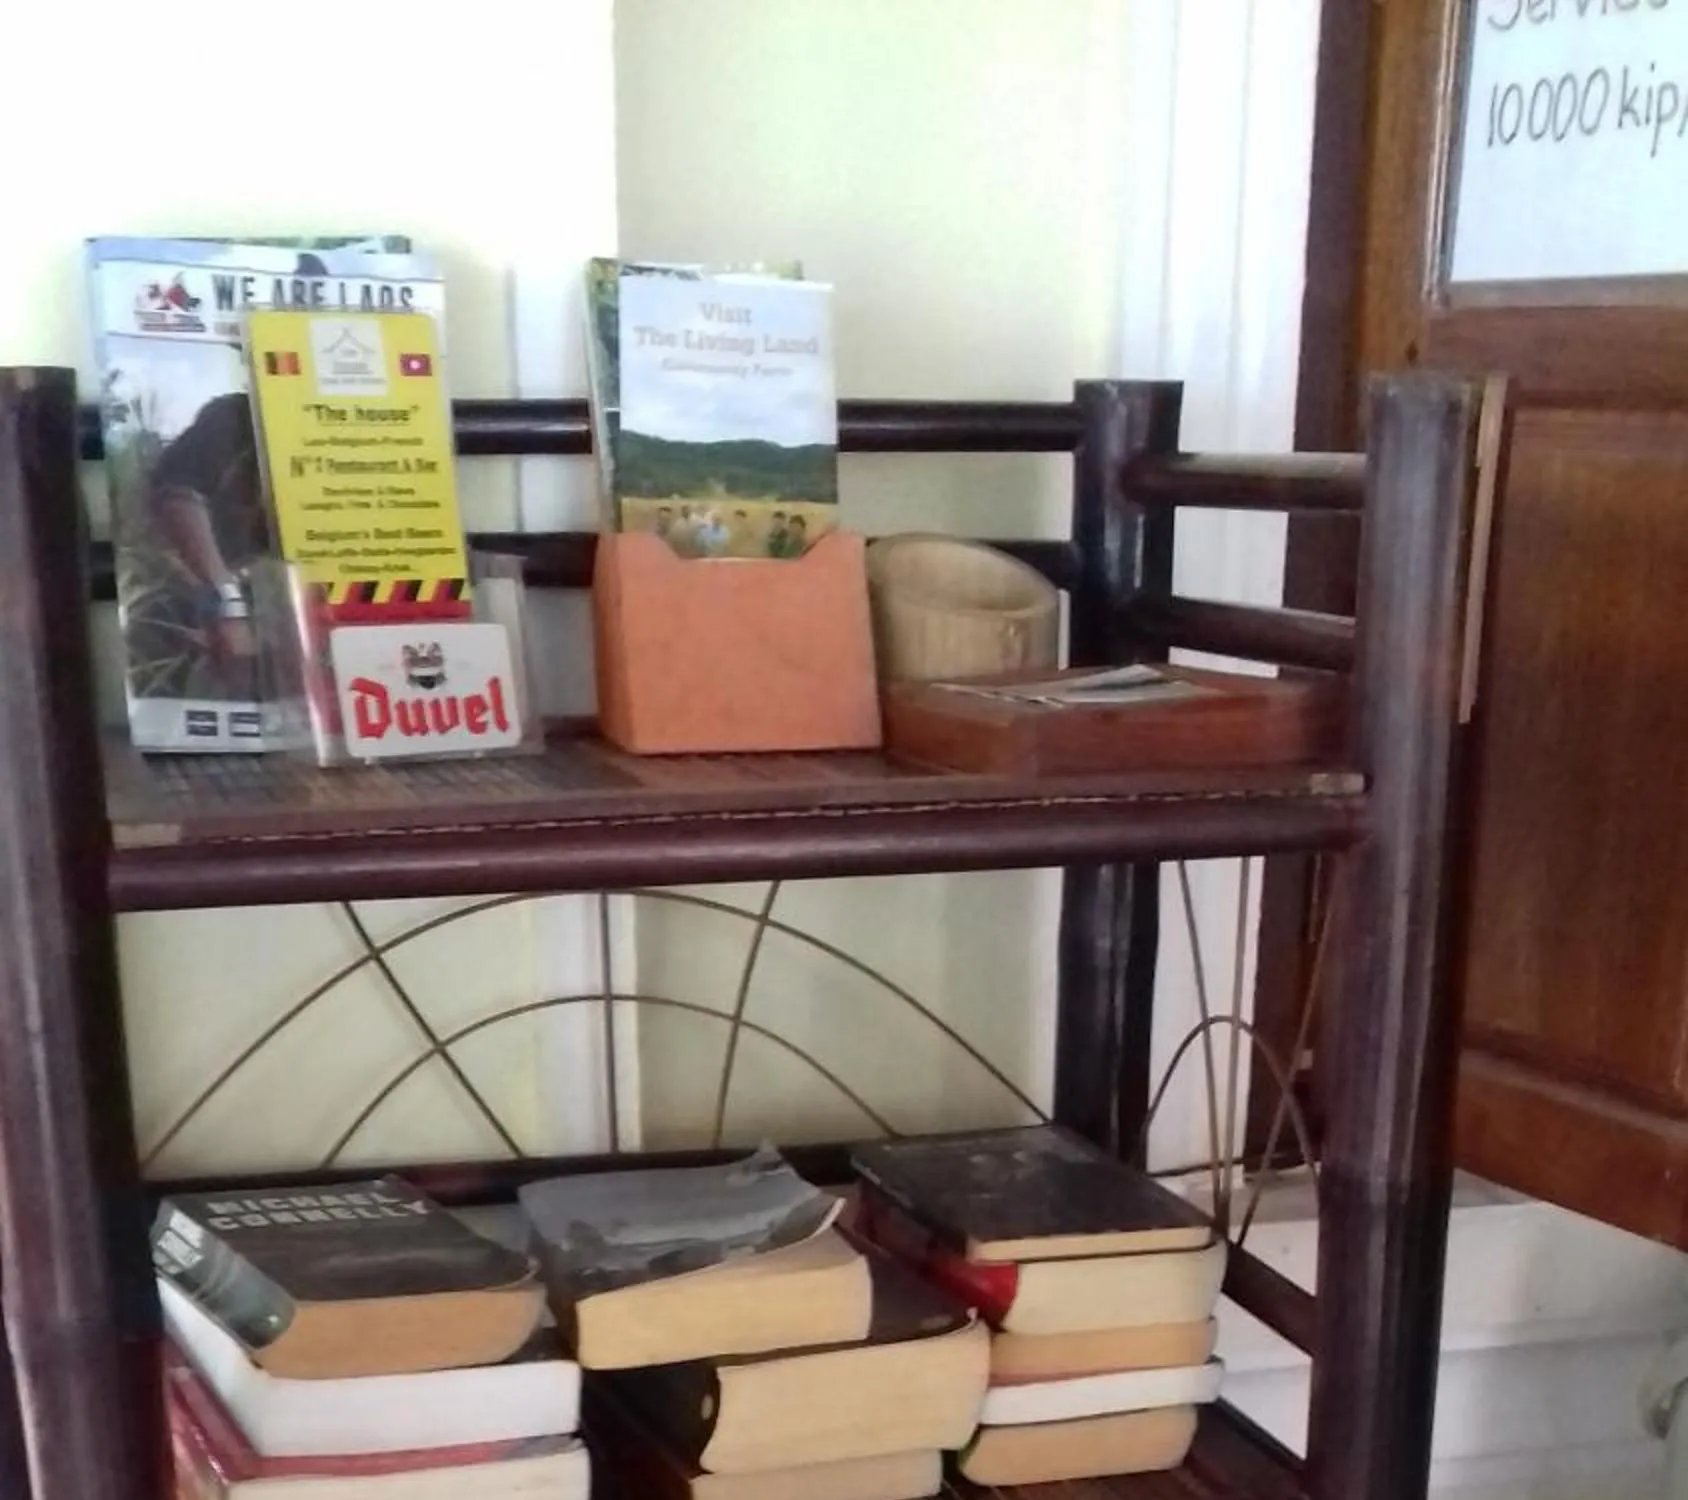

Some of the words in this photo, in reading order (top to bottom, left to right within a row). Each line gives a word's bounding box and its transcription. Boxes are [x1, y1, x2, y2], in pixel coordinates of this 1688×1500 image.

[211, 273, 256, 312] WE
[271, 277, 324, 312] ARE
[700, 302, 752, 325] Visit
[632, 325, 678, 348] The
[683, 328, 755, 357] Living
[763, 333, 820, 354] Land
[349, 675, 511, 740] Duvel
[206, 1192, 400, 1214] MICHAEL
[207, 1201, 430, 1231] CONNELLY
